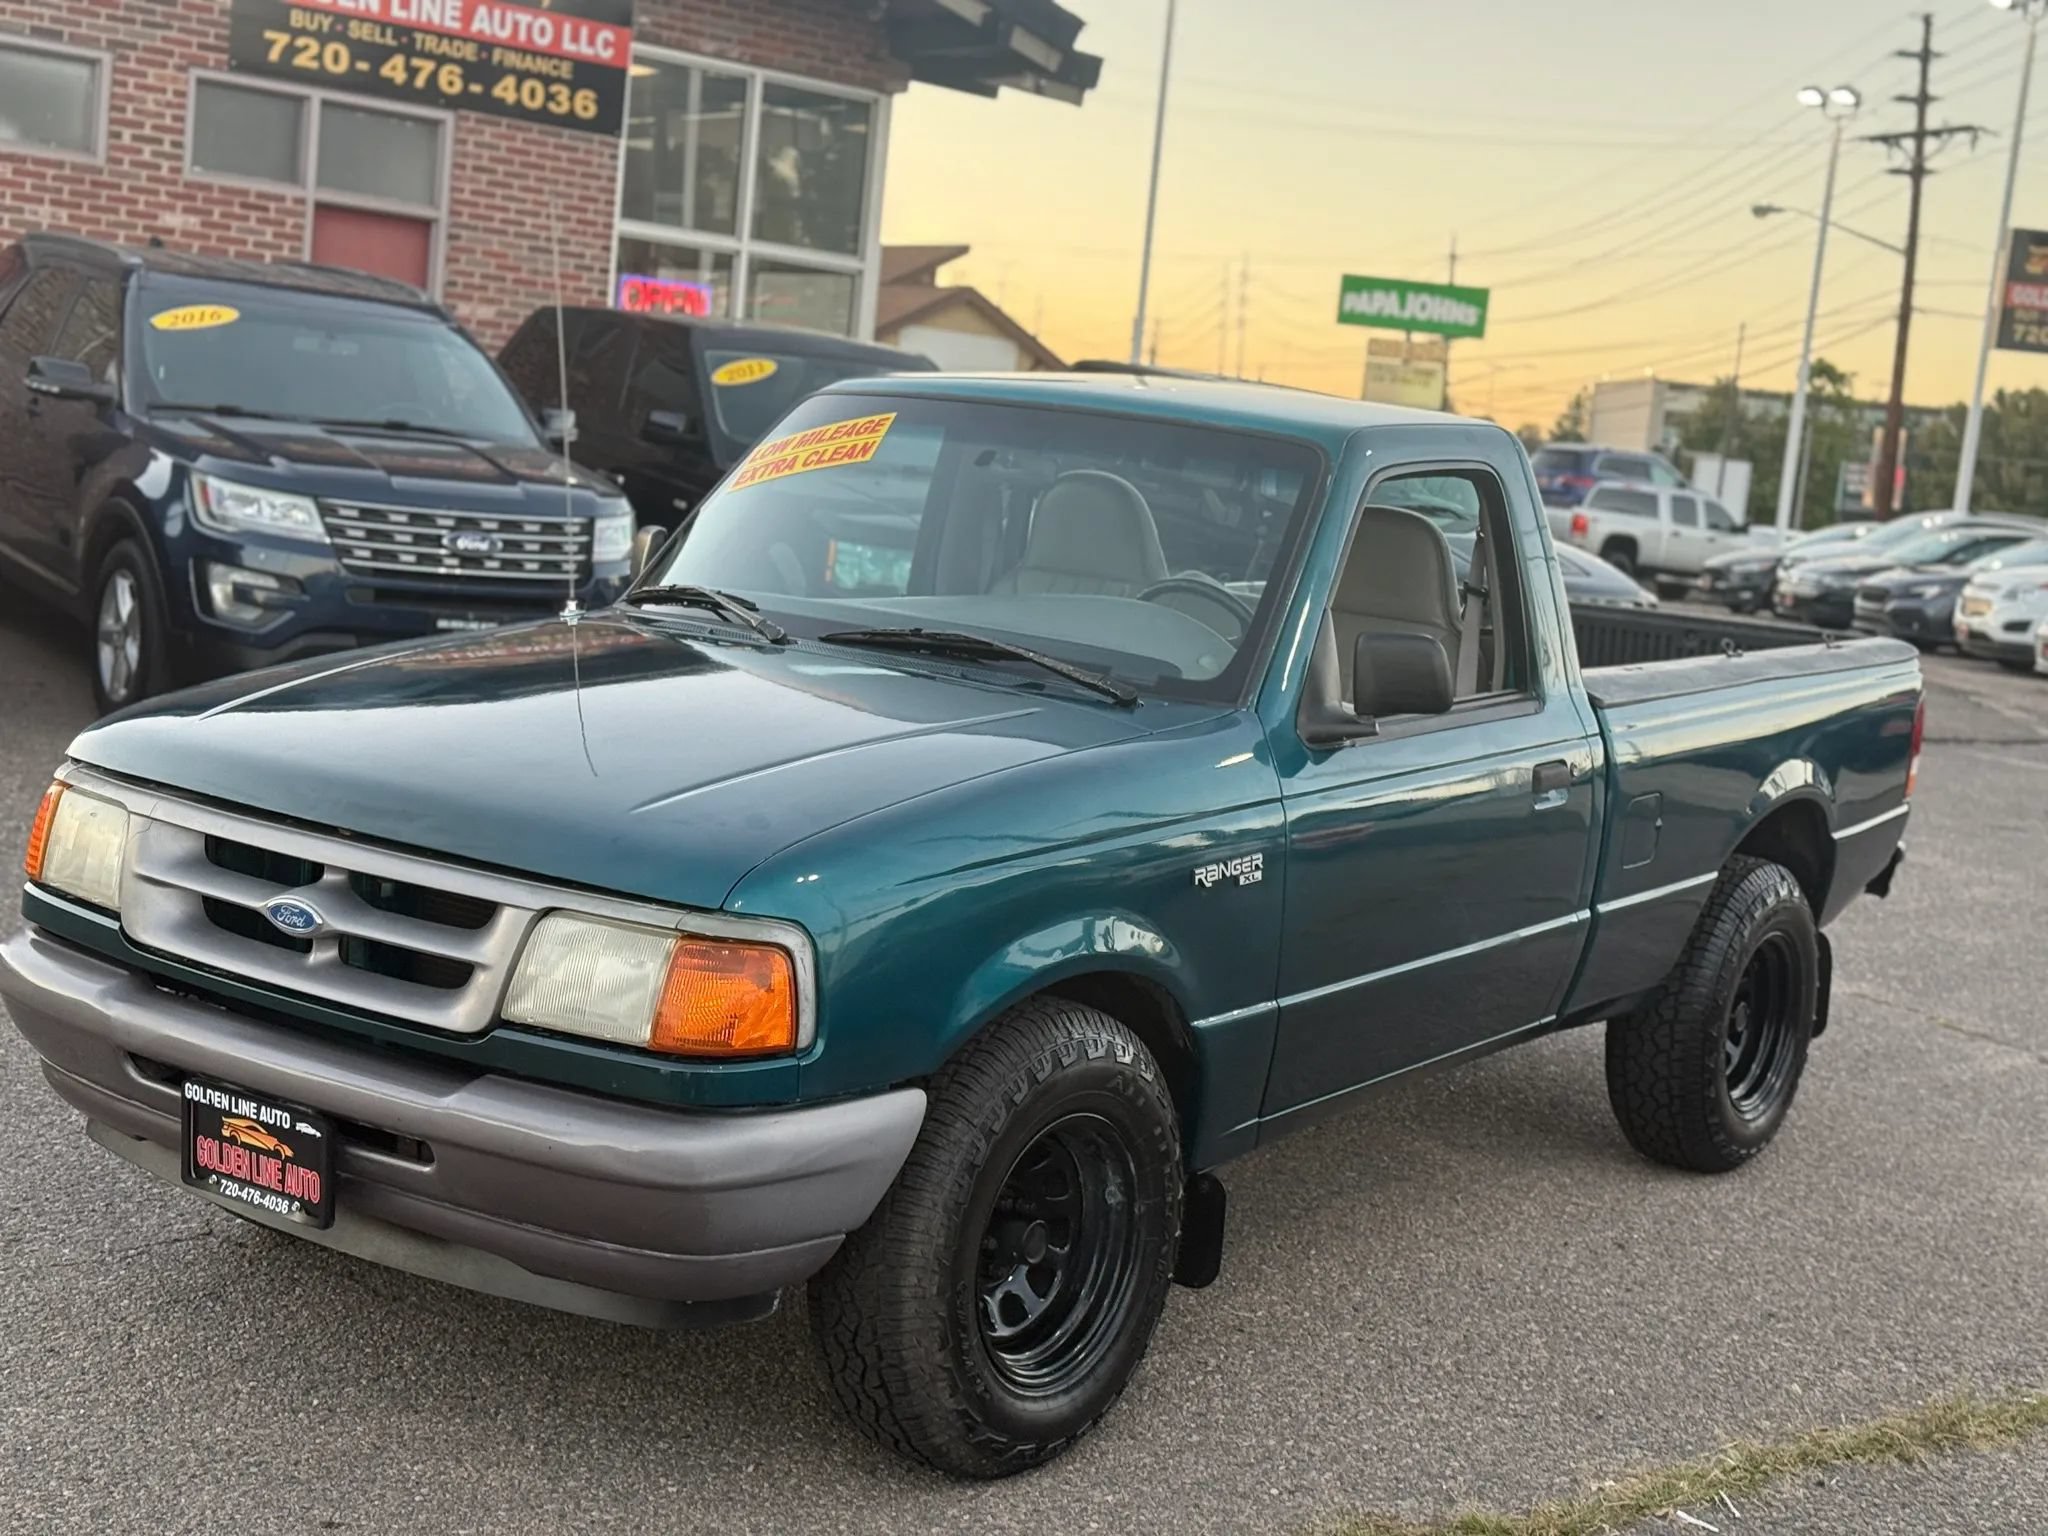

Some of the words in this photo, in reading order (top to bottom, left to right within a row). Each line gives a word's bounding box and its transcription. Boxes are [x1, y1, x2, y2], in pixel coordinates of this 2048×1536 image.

[289, 8, 334, 33] BUY
[347, 19, 398, 46] SELL
[412, 30, 479, 62] TRADE
[491, 46, 574, 79] FINANCE
[390, 0, 463, 30] LINE
[470, 4, 554, 47] AUTO
[561, 21, 615, 59] LLC
[168, 309, 222, 327] 2016
[622, 279, 711, 317] OPEN
[725, 361, 767, 382] 2011
[750, 437, 794, 462] LOW
[793, 417, 891, 451] MILEAGE
[732, 454, 799, 488] EXTRA
[801, 441, 877, 468] CLEAN
[1194, 852, 1263, 887] RANGER
[277, 905, 306, 928] Ford
[184, 1082, 230, 1111] GOLDEN
[231, 1096, 258, 1120] LINE
[258, 1105, 291, 1129] AUTO
[196, 1135, 251, 1181] GOLDEN
[251, 1152, 283, 1192] LINE
[284, 1162, 321, 1204] AUTO
[219, 1179, 290, 1214] 720-476-4036
